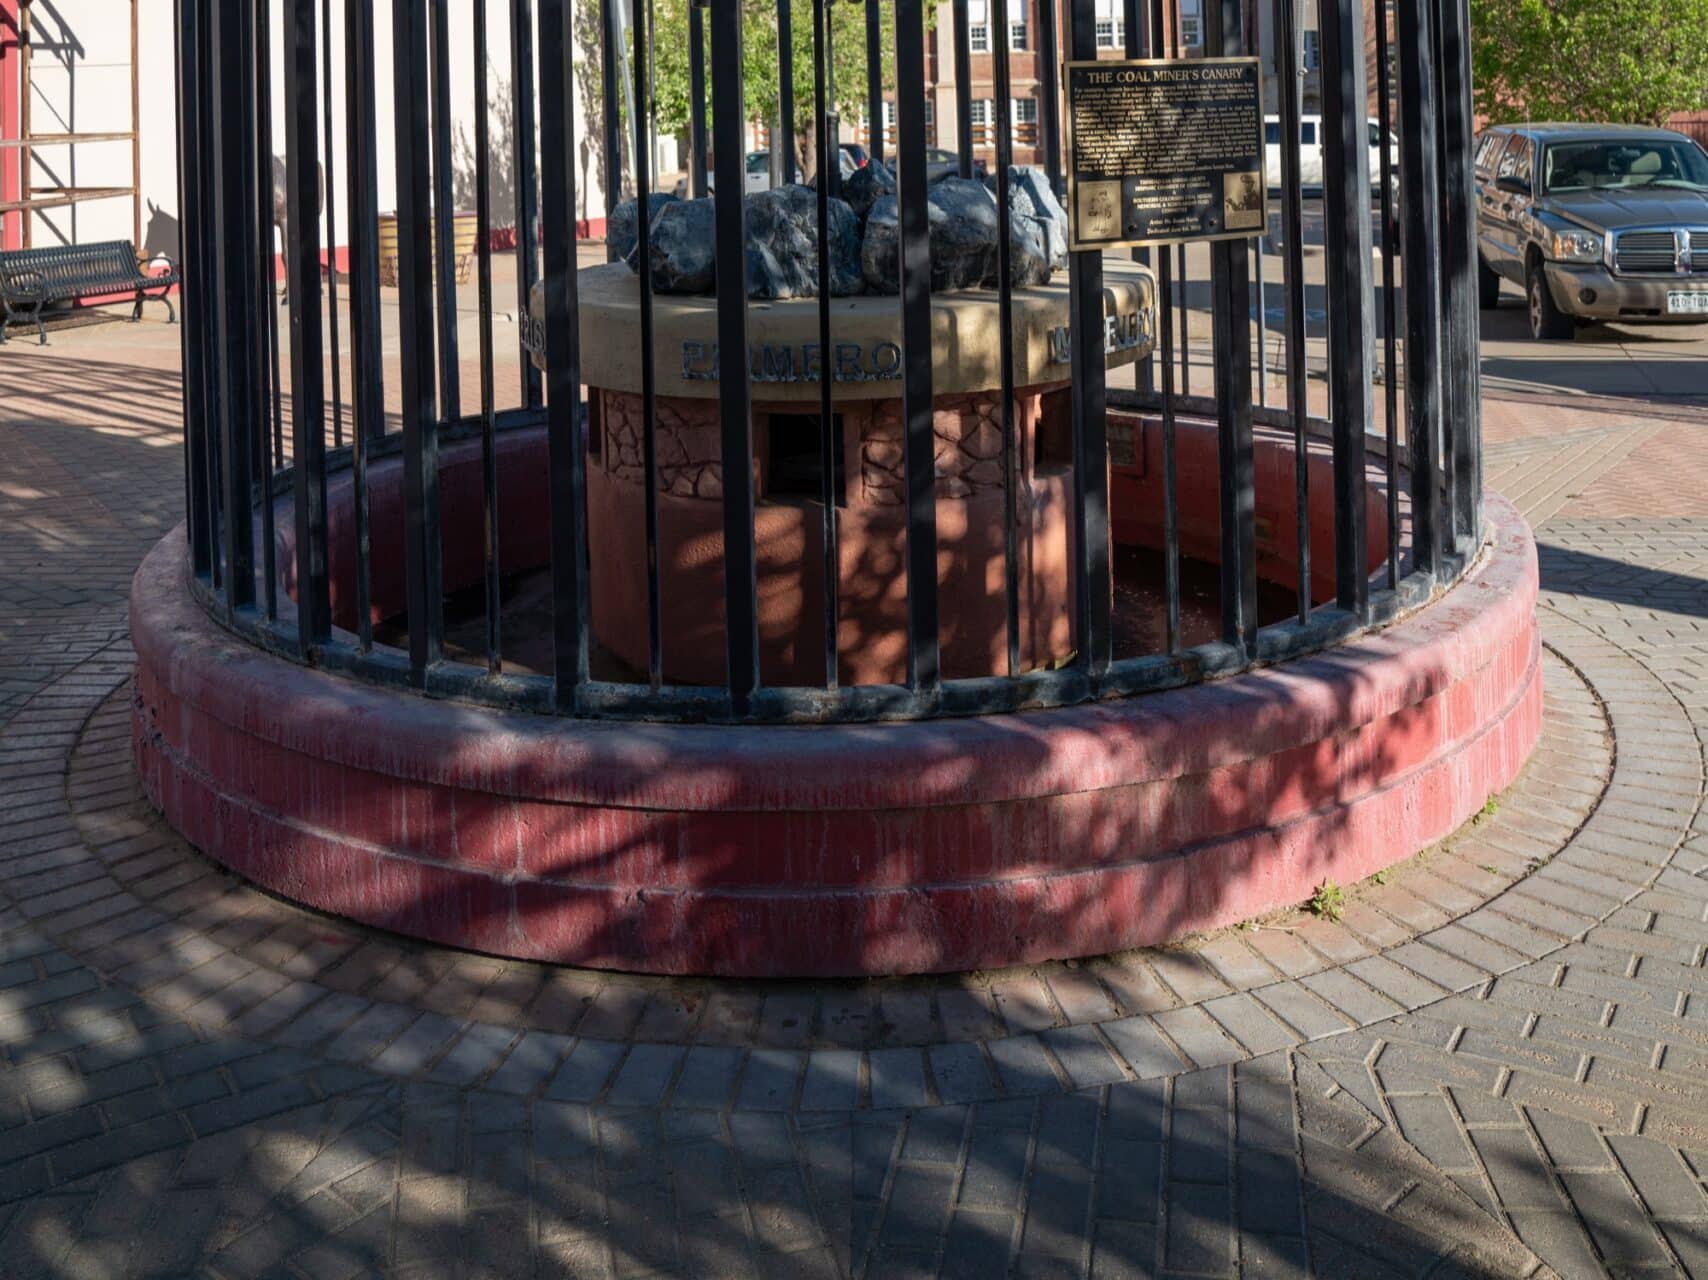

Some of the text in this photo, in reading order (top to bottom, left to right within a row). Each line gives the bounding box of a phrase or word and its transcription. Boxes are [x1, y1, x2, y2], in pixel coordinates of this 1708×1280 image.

[1088, 68, 1243, 84] THE COAL MINER'S CANARY
